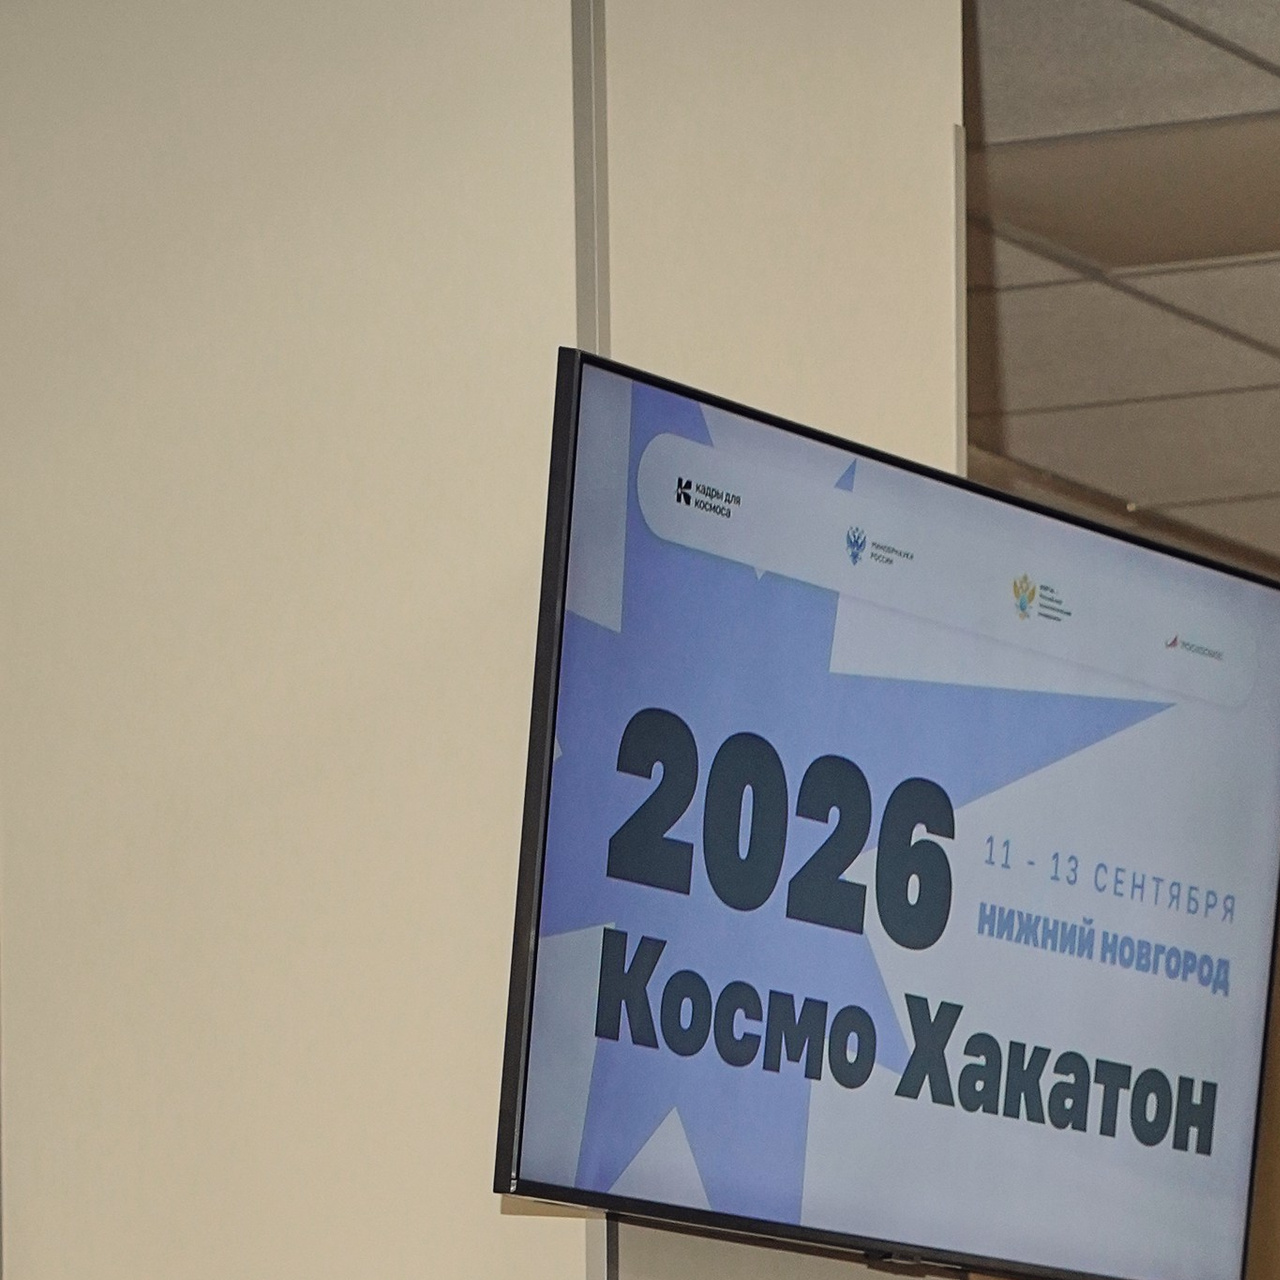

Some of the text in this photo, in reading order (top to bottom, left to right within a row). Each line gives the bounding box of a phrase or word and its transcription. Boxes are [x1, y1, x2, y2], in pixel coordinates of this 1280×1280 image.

[694, 498, 732, 519] космоса
[695, 483, 742, 506] кадры для
[607, 707, 955, 950] 2026
[984, 835, 1011, 869] 11
[1050, 852, 1079, 886] 13
[1094, 863, 1236, 923] СЕНТЯБРЯ
[977, 901, 1231, 997] НИЖНИЙ НОВГОРОД
[595, 927, 1218, 1156] Космо Хакатон
